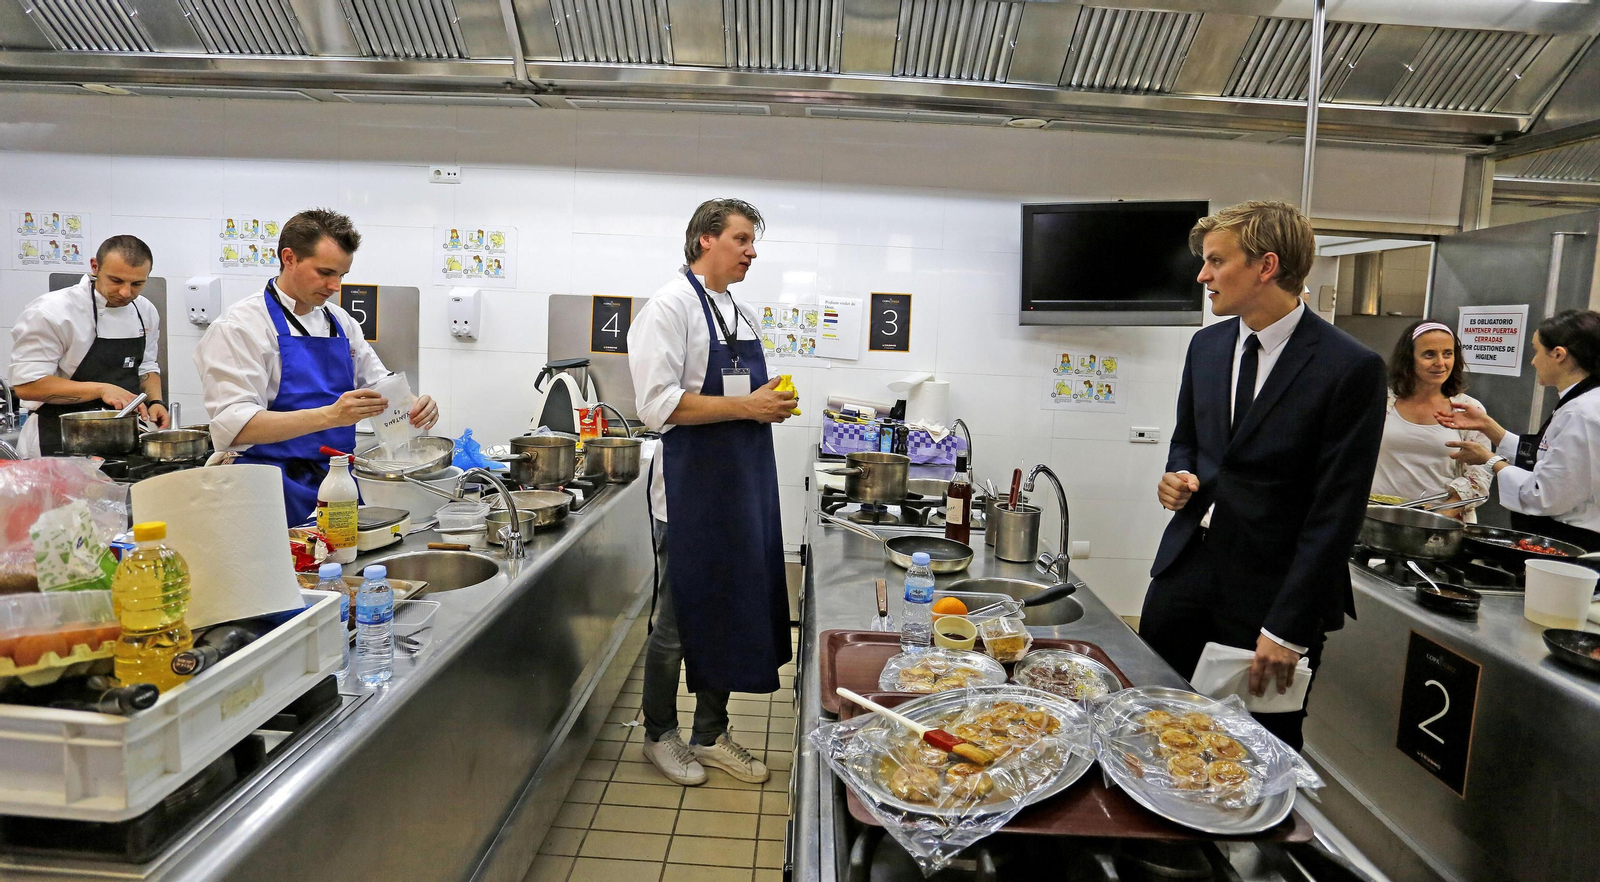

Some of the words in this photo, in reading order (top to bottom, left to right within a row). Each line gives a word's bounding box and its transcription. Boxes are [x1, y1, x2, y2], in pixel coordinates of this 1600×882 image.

[352, 300, 367, 325] 5
[601, 312, 621, 338] 4
[881, 309, 898, 336] 3
[1492, 327, 1518, 335] PUERTAS
[1473, 344, 1506, 352] CUESTIONES
[1418, 679, 1450, 745] 2
